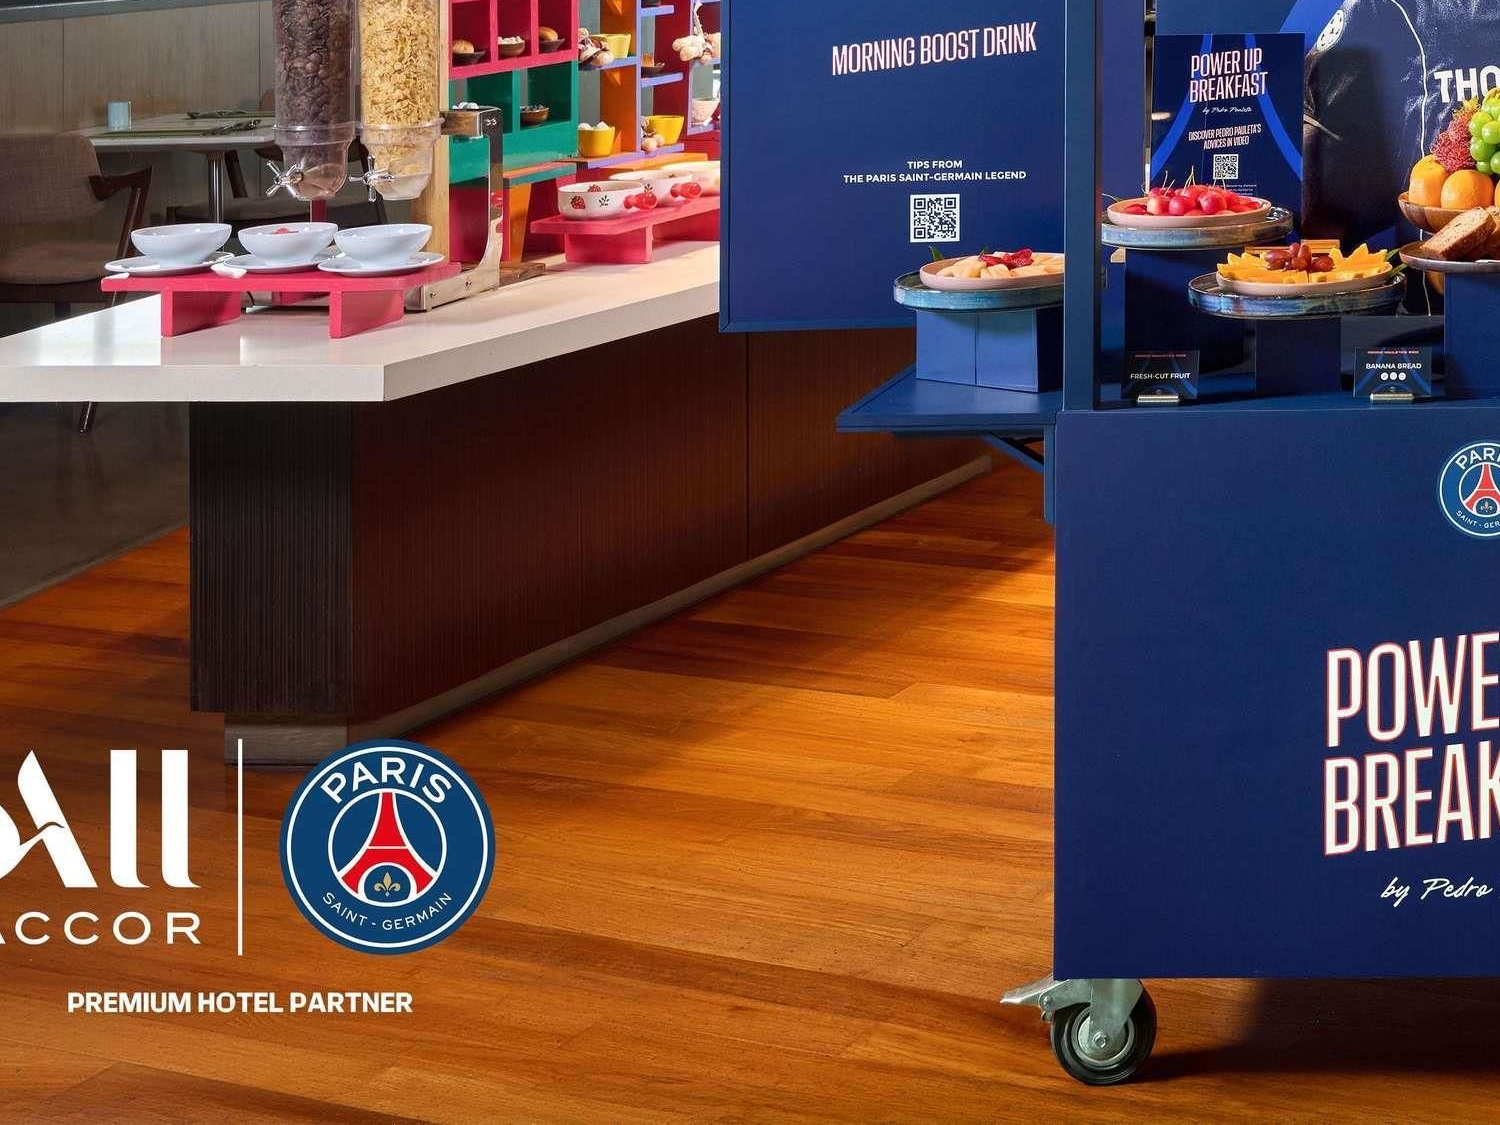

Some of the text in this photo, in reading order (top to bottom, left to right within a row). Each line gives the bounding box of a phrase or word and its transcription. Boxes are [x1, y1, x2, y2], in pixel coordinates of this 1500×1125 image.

[832, 21, 1037, 76] MORNING BOOST DRINK
[1190, 48, 1262, 79] POWER UP
[1189, 72, 1268, 103] BREAKFAST
[1188, 129, 1215, 141] DISCOVER
[1215, 126, 1233, 138] PEDRO
[1203, 135, 1250, 150] ADVICES IN VIDEO
[907, 160, 963, 170] TIPS FROM
[843, 170, 1027, 183] THE PARIS SAINT-GERMAIN LEGEND
[1365, 362, 1422, 370] BANANA BREAD
[1130, 372, 1169, 380] FRESH-CUT
[1380, 876, 1409, 907] by
[1420, 876, 1493, 900] Pedro
